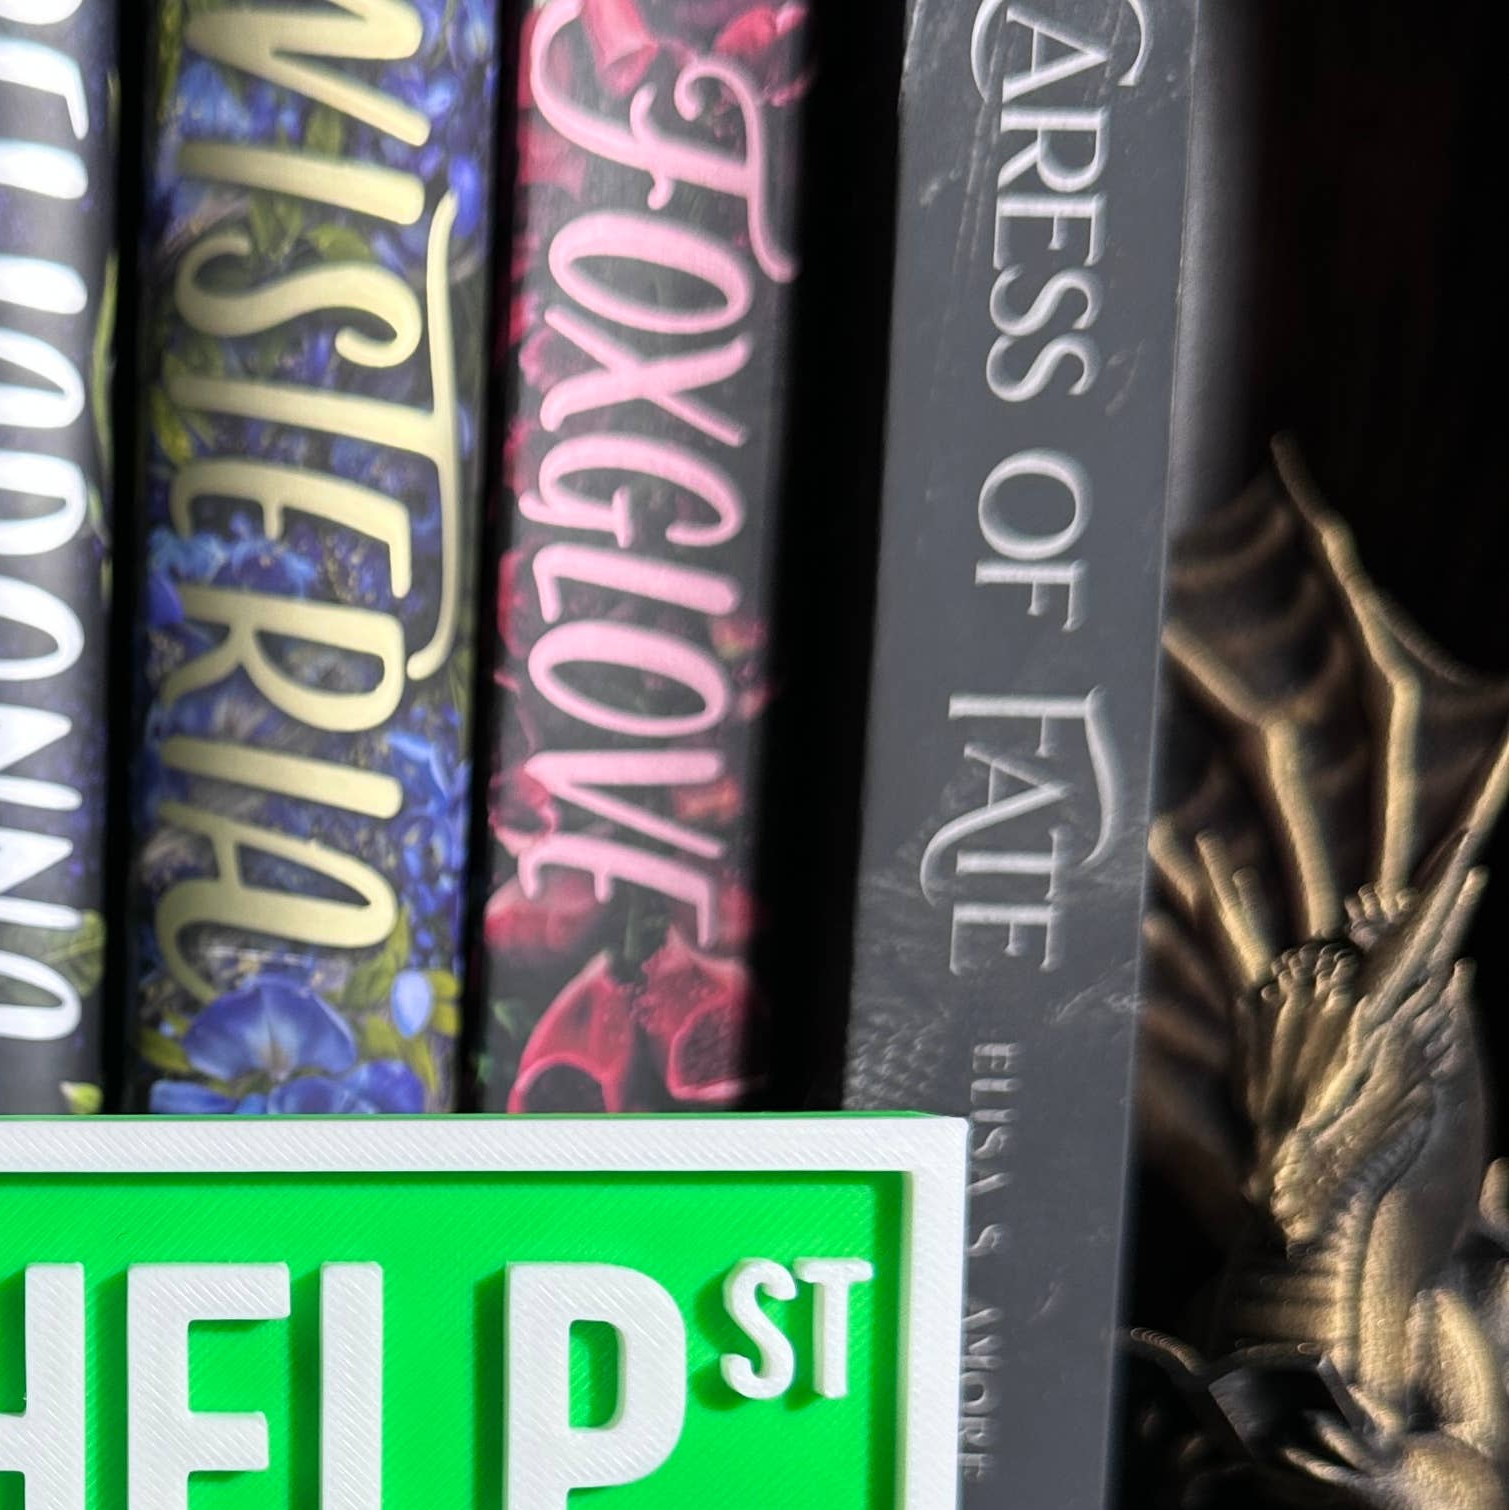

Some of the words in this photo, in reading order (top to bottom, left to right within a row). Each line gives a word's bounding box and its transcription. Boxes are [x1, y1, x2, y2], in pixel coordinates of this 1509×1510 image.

[970, 0, 1155, 402] CARESS
[517, 0, 795, 947] FOXGLOVE
[975, 448, 1090, 632] OF
[920, 687, 1118, 975] FATE
[720, 1258, 874, 1400] ST
